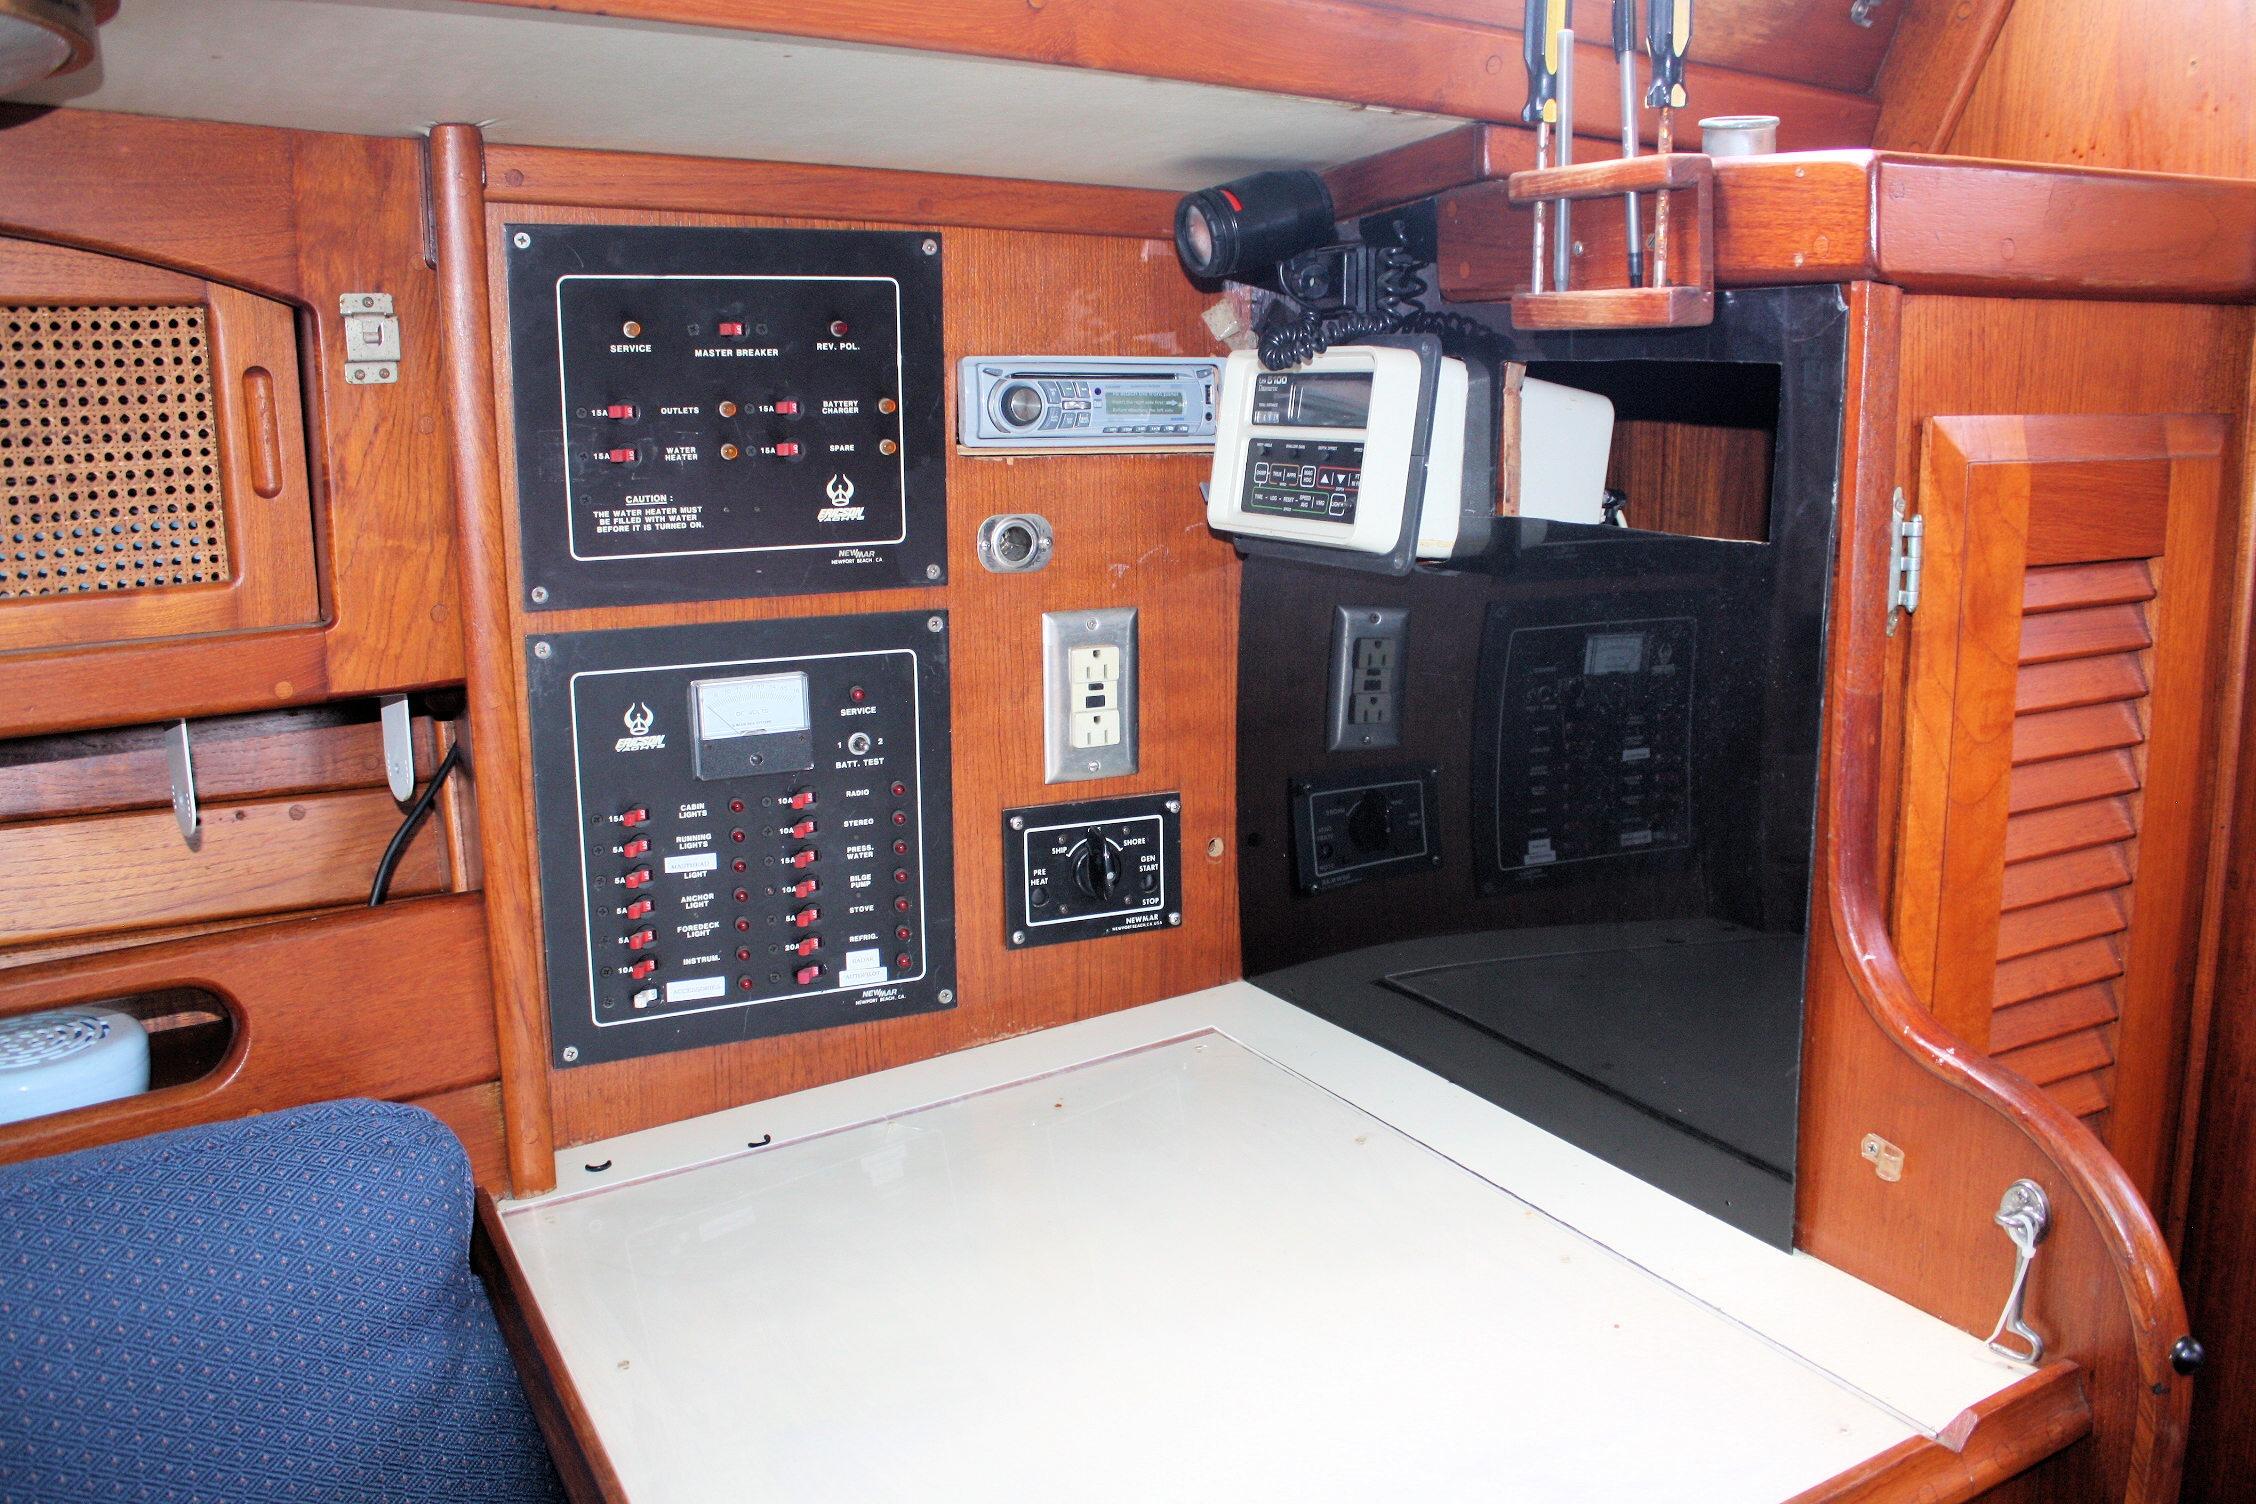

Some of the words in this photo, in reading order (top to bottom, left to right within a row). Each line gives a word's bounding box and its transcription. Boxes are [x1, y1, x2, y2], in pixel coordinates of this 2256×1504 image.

[610, 344, 652, 353] SERVICE
[840, 342, 860, 350] POL.
[694, 349, 733, 357] MASTER
[736, 348, 779, 357] BREAKER
[591, 409, 608, 417] 15A
[661, 407, 700, 415] OUTLETS
[666, 447, 696, 455] WATER
[829, 444, 855, 452] SPARE
[665, 453, 698, 461] HEATER
[613, 509, 642, 517] WATER
[680, 506, 703, 514] MUST
[597, 525, 629, 533] BEFORE
[655, 522, 687, 530] TURNED
[838, 549, 875, 558] NEWMAR
[840, 706, 877, 716] SERVICE
[836, 760, 861, 769] BATT.
[863, 757, 885, 766] TEST
[846, 789, 870, 797] RADIO
[680, 802, 705, 812] CABIN
[679, 809, 708, 819] LIGHTS
[608, 815, 624, 823] 15A
[843, 818, 874, 827] STEREO
[676, 833, 712, 843] RUNNING
[1123, 837, 1146, 846] SHORE
[679, 841, 709, 850] LIGHTS
[847, 845, 874, 853] PRESS.
[1051, 846, 1068, 855] SHIP
[847, 851, 874, 860] WATER
[1140, 855, 1156, 863] GEN
[780, 857, 796, 865] 15A
[1033, 868, 1047, 876] PRE
[1139, 863, 1159, 872] START
[684, 870, 708, 880] LIGHT
[850, 874, 872, 882] BILGE
[850, 880, 872, 889] PUMP
[1030, 877, 1049, 886] HEAT
[782, 886, 797, 894] 10A
[680, 893, 715, 903] ANCHOR
[1142, 897, 1160, 906] STOP
[685, 900, 710, 910] LIGHT
[849, 905, 875, 914] STOVE
[1125, 913, 1159, 925] NEWMAR
[677, 921, 720, 933] FOREDECK
[686, 929, 711, 938] LIGHT
[849, 933, 878, 943] REFRIG.
[784, 943, 800, 951] 20A
[683, 954, 721, 966] INSTRUM.
[618, 966, 634, 974] 10A
[862, 988, 898, 998] NEWMAR
